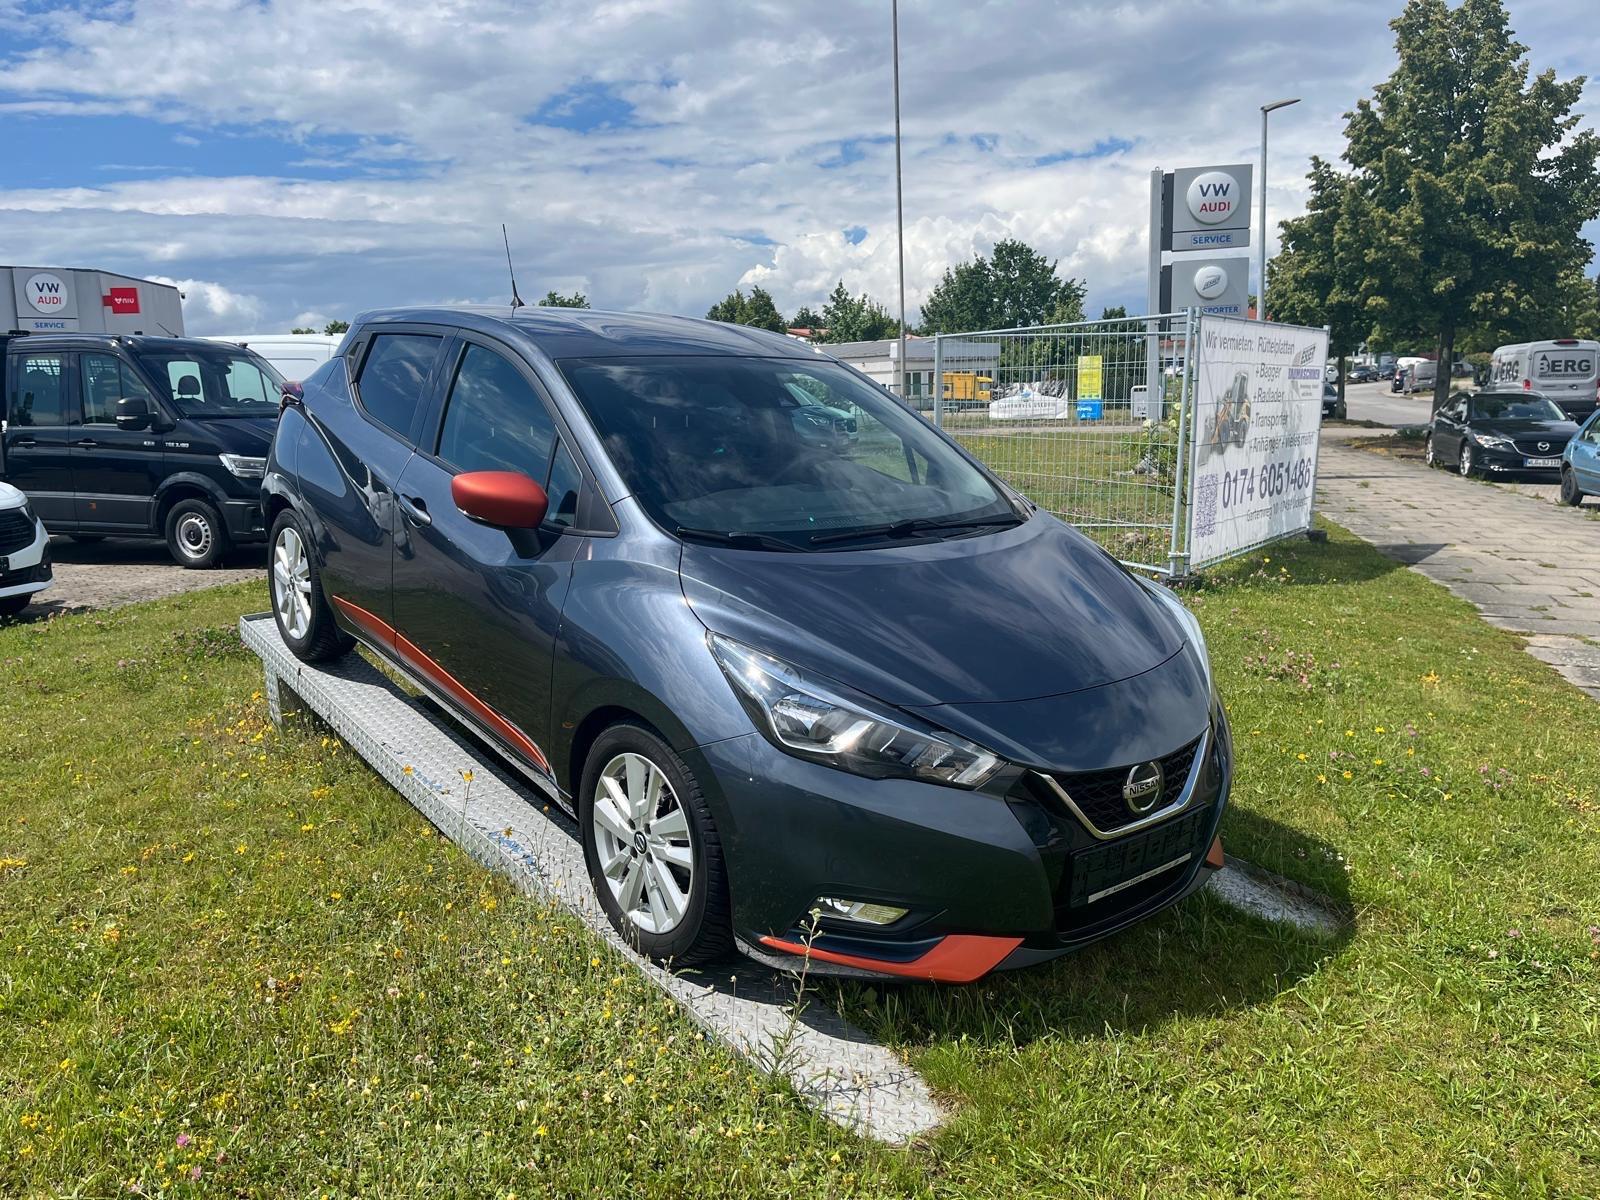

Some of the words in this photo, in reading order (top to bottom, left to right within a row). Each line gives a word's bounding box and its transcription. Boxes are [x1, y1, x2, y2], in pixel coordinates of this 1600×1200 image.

[1199, 183, 1230, 197] VW
[1199, 201, 1230, 213] AUDI
[1192, 234, 1232, 245] SERVICE
[35, 282, 60, 293] VW
[37, 295, 62, 305] AUDI
[1205, 331, 1217, 349] Wir
[1539, 354, 1591, 373] BERG
[1223, 466, 1255, 508] 0174
[1260, 457, 1312, 499] 6051486
[1130, 779, 1160, 795] NISSAN
